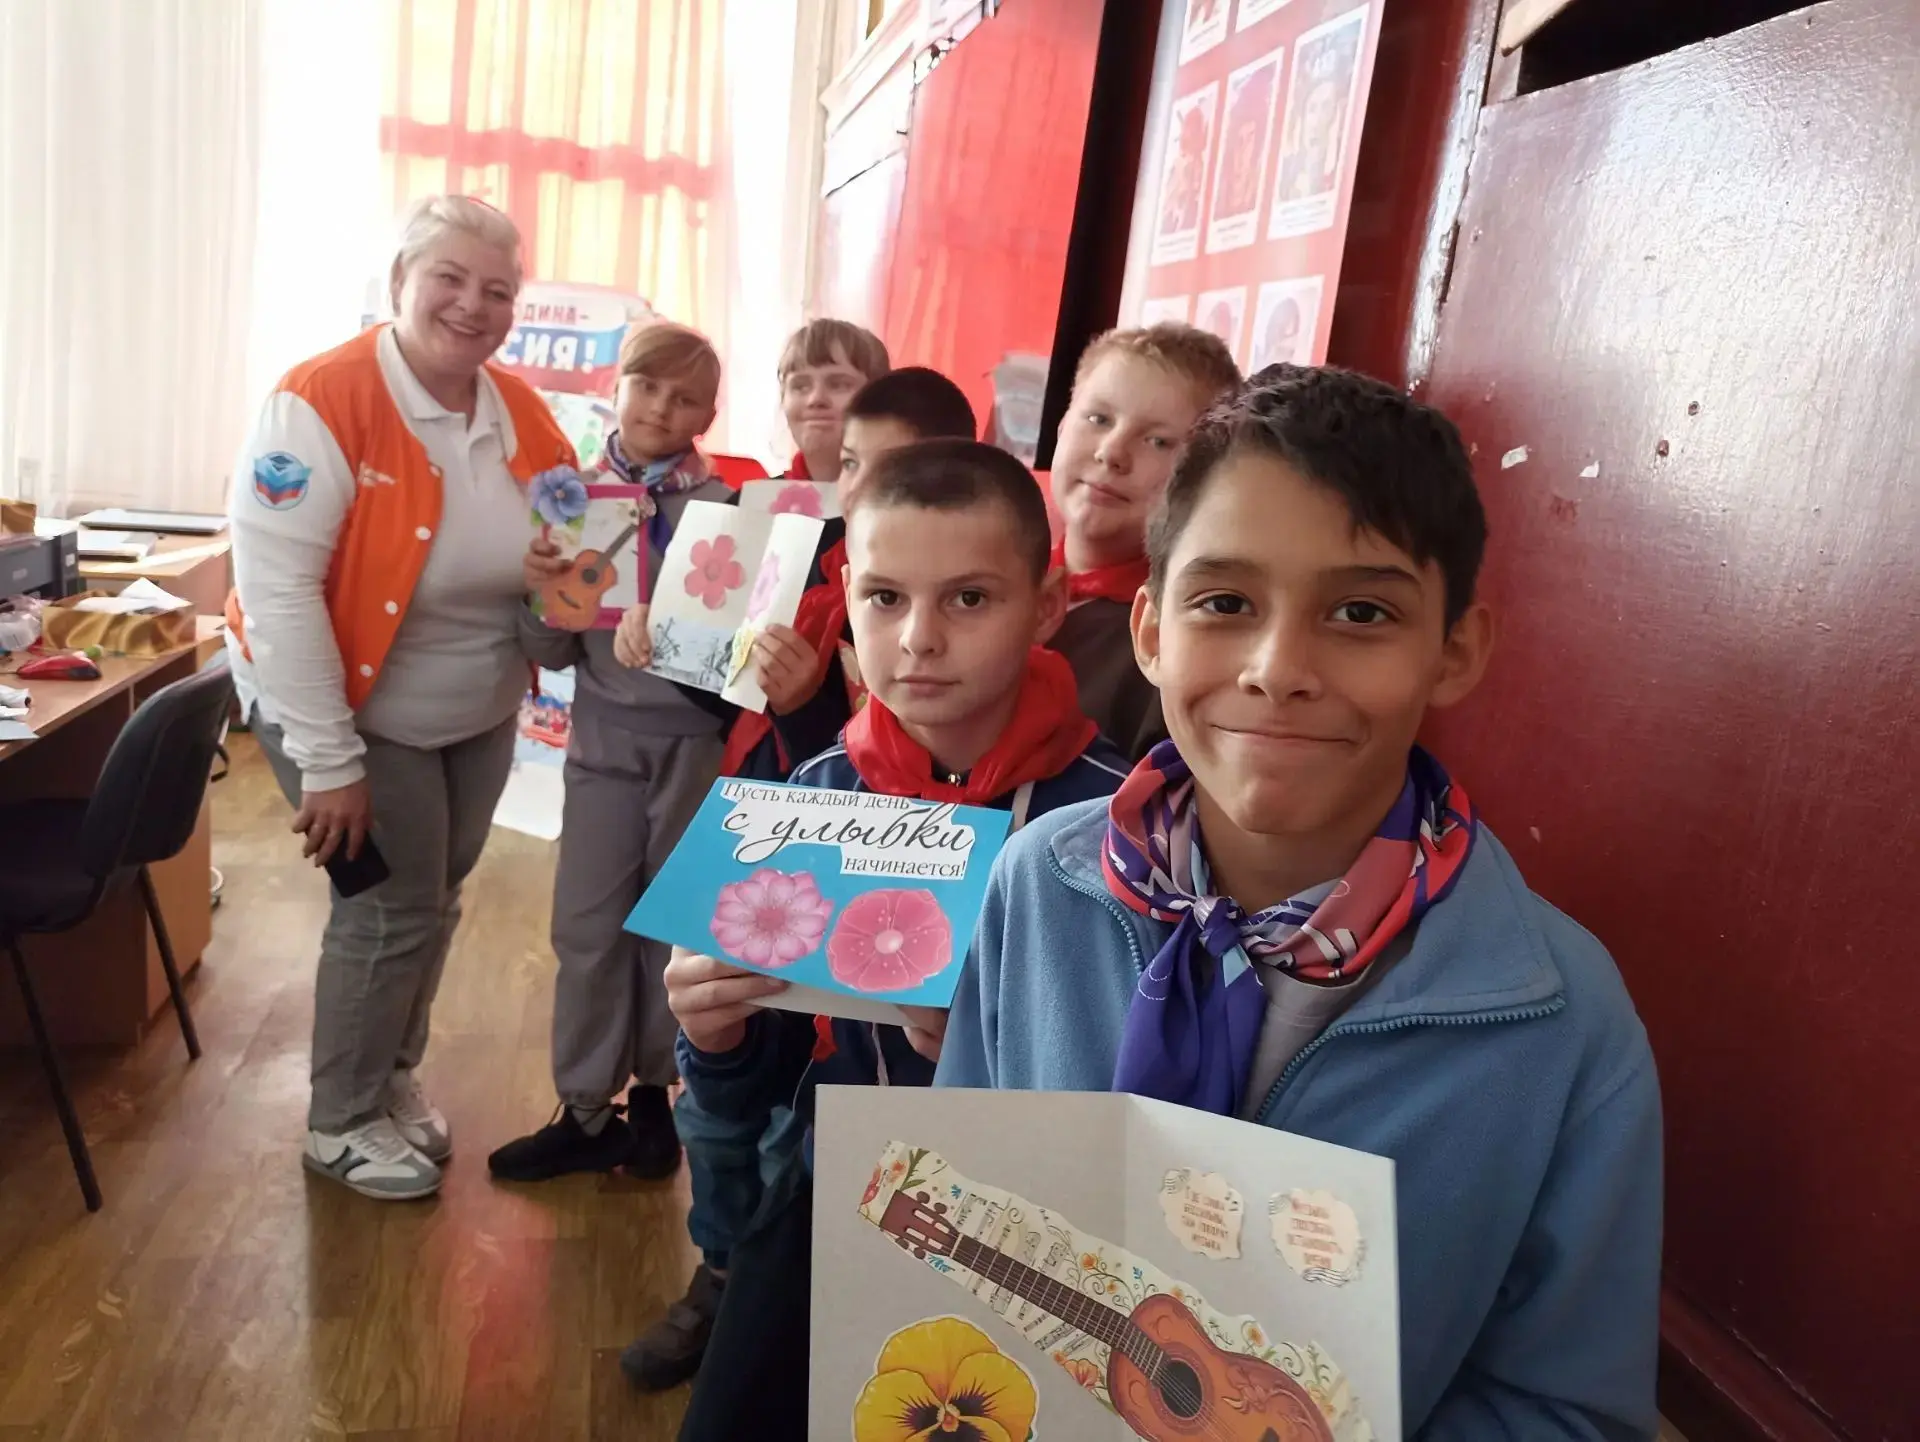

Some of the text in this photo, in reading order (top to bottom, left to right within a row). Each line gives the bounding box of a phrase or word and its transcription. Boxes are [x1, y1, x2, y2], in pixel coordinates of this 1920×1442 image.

[497, 332, 598, 374] СИЯ!
[724, 783, 910, 810] Пусть каждый день
[724, 802, 974, 865] с улыбки
[844, 857, 967, 877] начинается!
